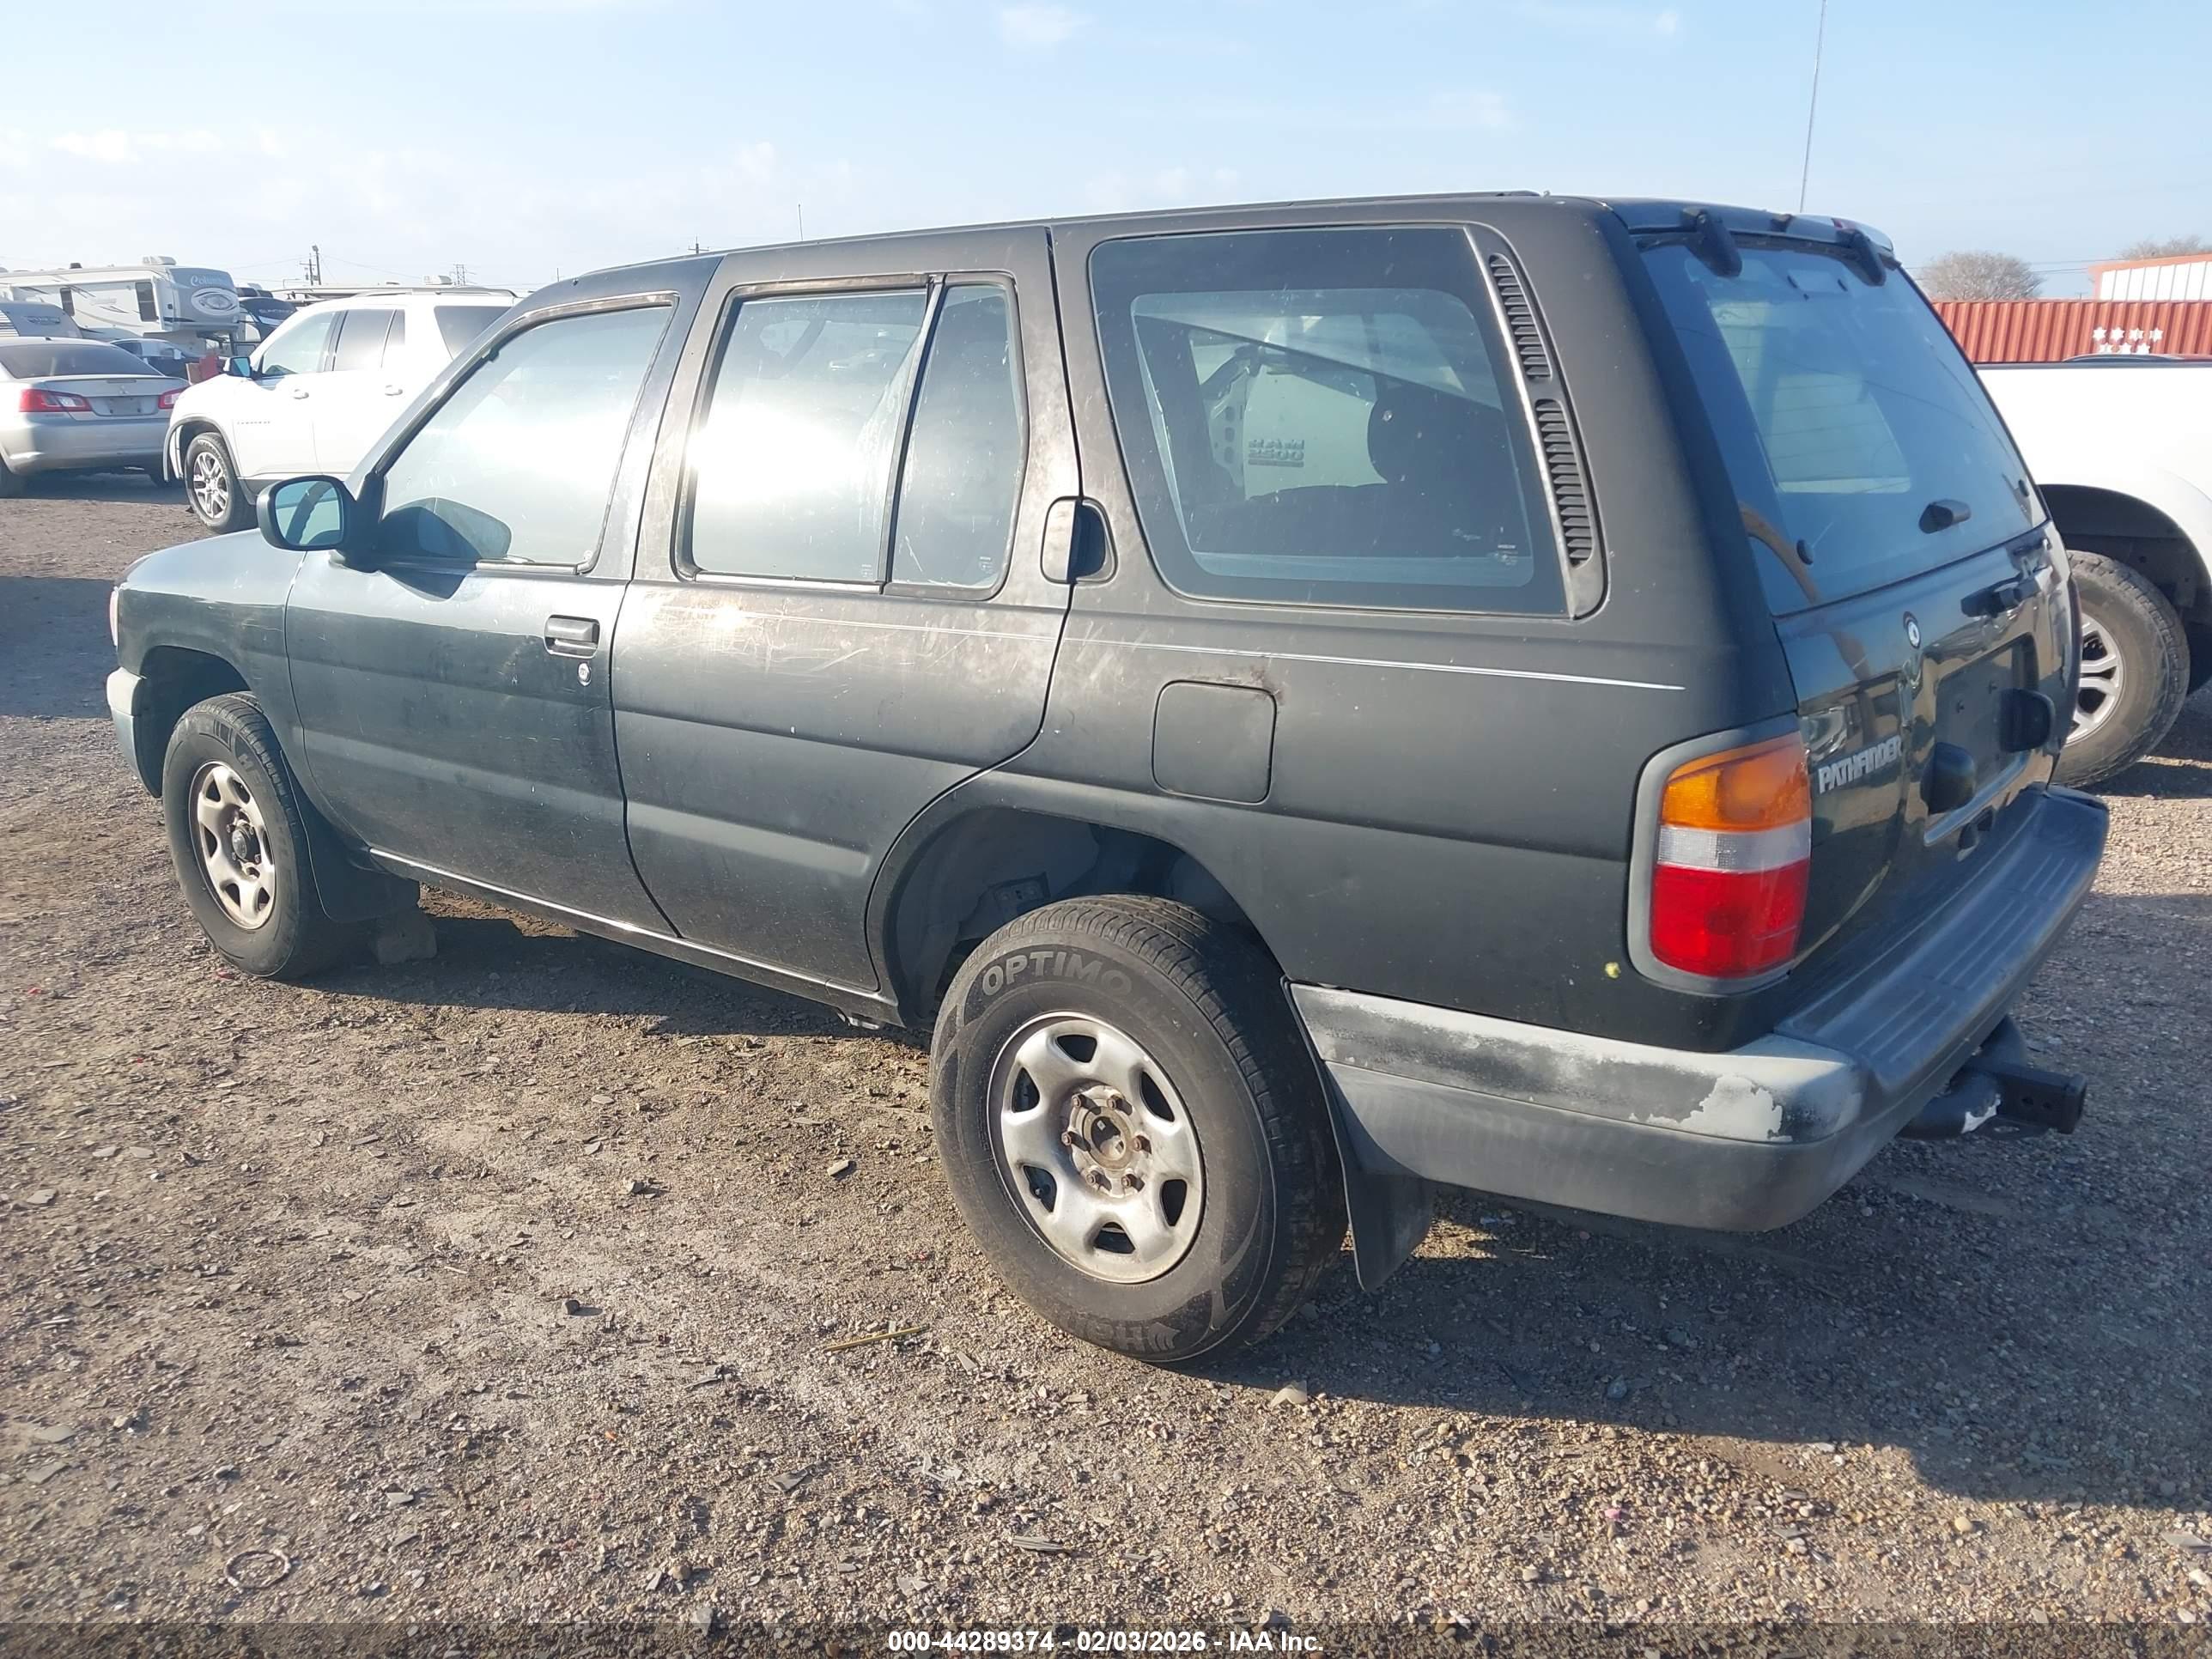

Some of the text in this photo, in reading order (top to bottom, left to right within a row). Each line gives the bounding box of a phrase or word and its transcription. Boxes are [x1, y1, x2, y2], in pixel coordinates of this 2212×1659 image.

[1249, 439, 1305, 451] RAM
[1249, 449, 1305, 461] 2500
[1818, 734, 1903, 794] PATHFINDER
[981, 950, 1133, 997] OPTIMO
